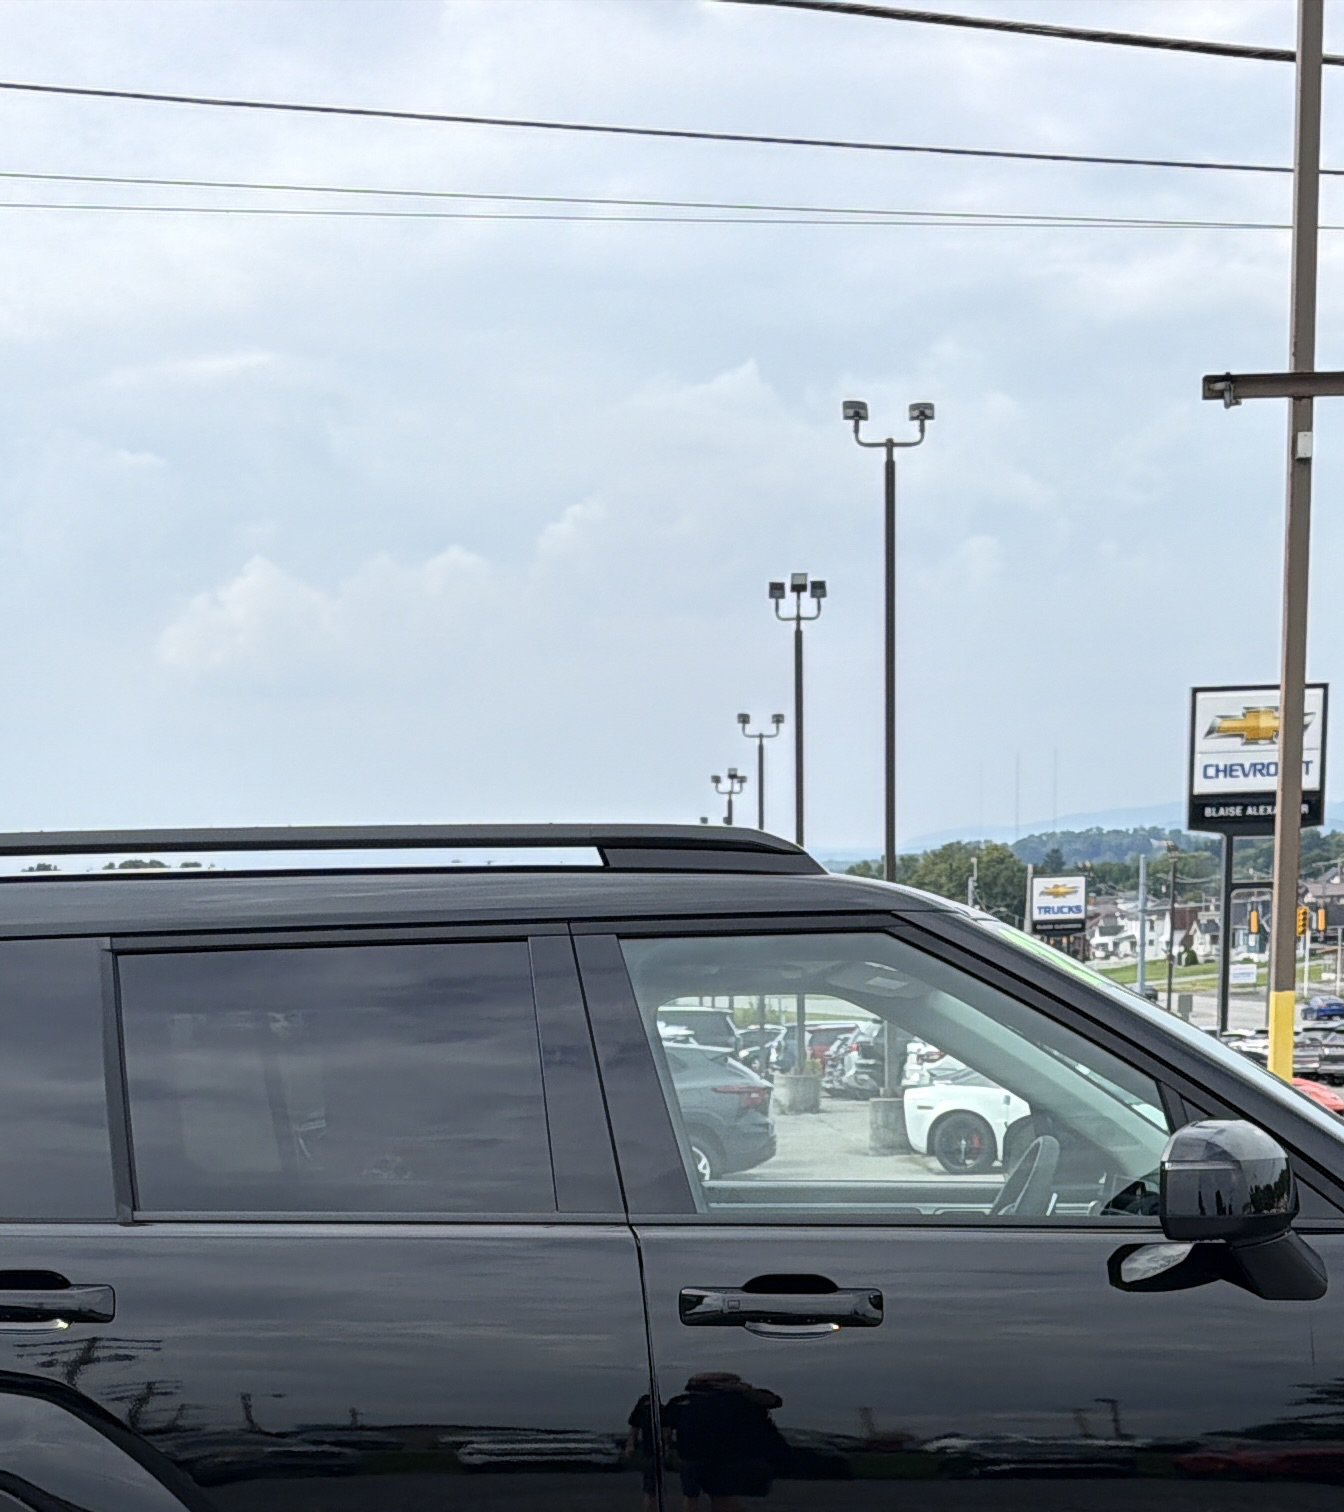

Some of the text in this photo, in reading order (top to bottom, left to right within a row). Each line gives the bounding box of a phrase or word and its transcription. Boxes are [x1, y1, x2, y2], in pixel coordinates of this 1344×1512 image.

[1202, 761, 1313, 780] CHEVROT
[1204, 806, 1242, 818] BLAISE
[1037, 905, 1082, 915] TRUCKS
